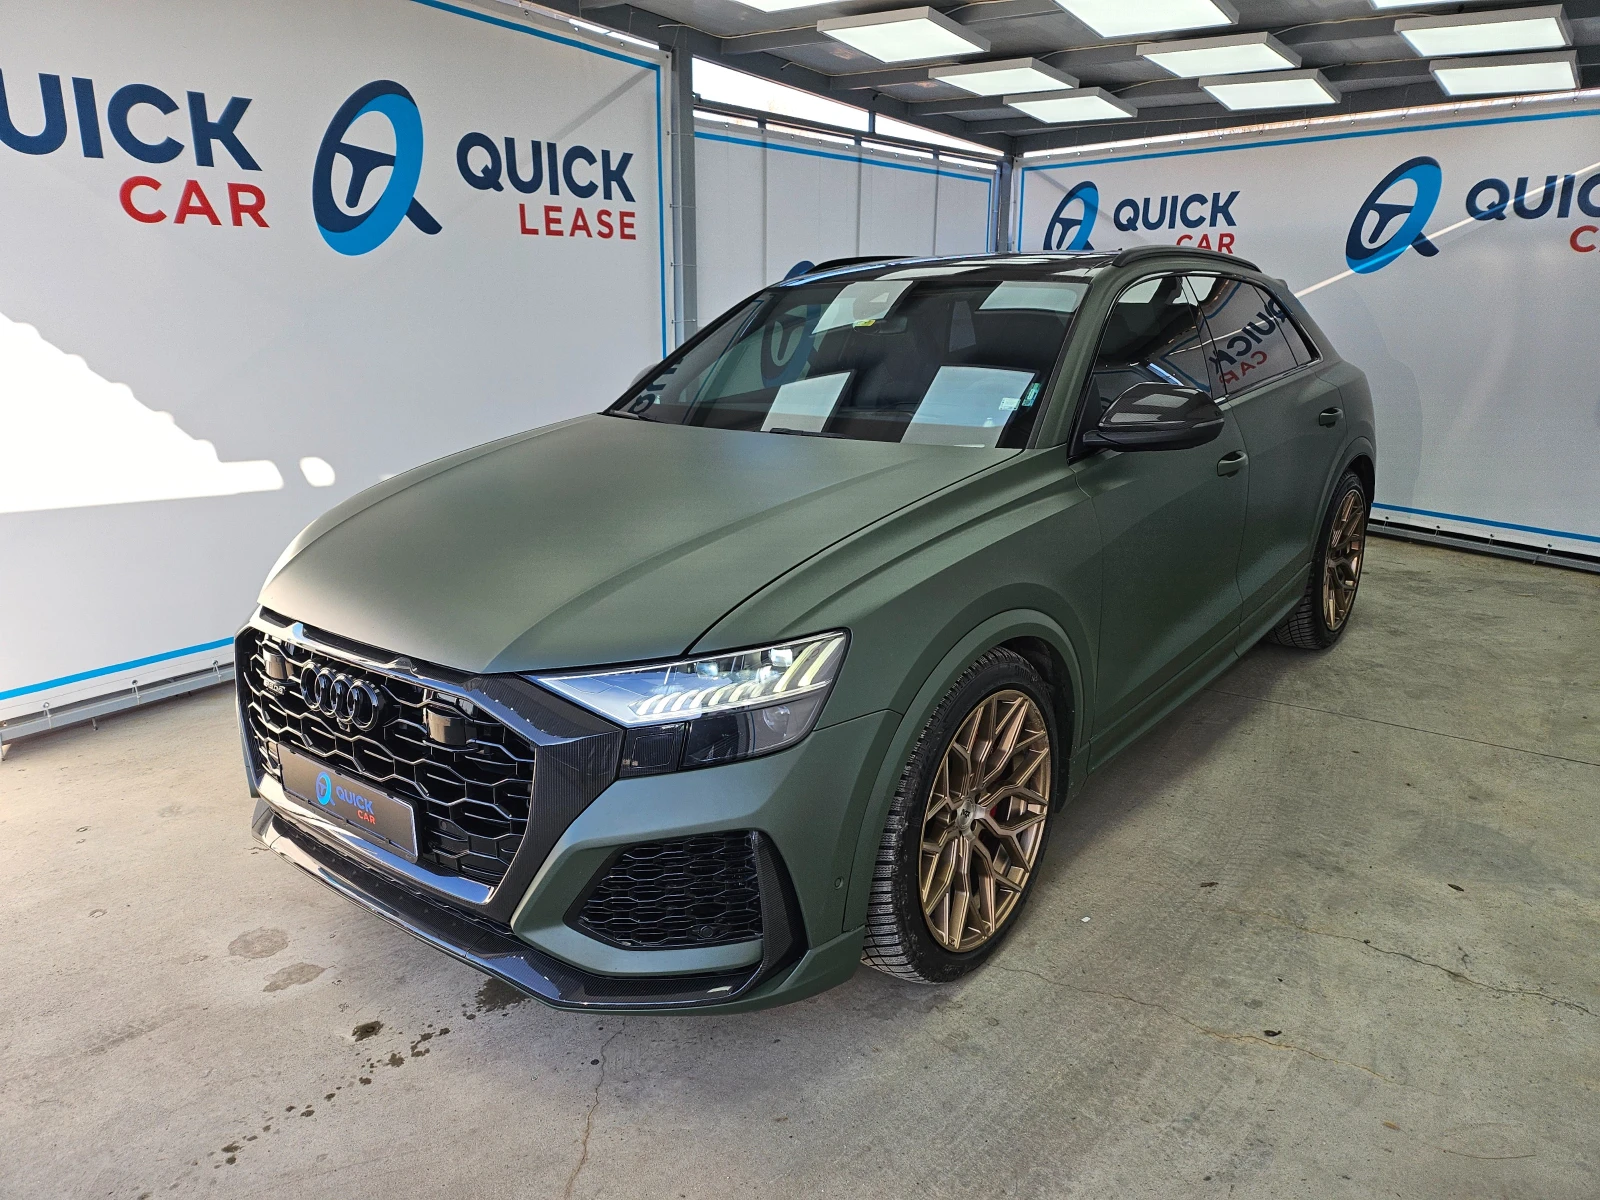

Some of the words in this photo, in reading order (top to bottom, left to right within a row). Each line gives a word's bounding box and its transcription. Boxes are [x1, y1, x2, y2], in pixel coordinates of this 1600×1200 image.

[0, 68, 263, 171] UICK
[456, 131, 636, 202] QUICK
[119, 175, 271, 228] CAR
[1113, 190, 1241, 231] QUICK
[1465, 172, 1600, 221] QUIC
[518, 203, 637, 240] LEASE
[335, 785, 375, 815] QUICK
[357, 809, 376, 825] CAR
